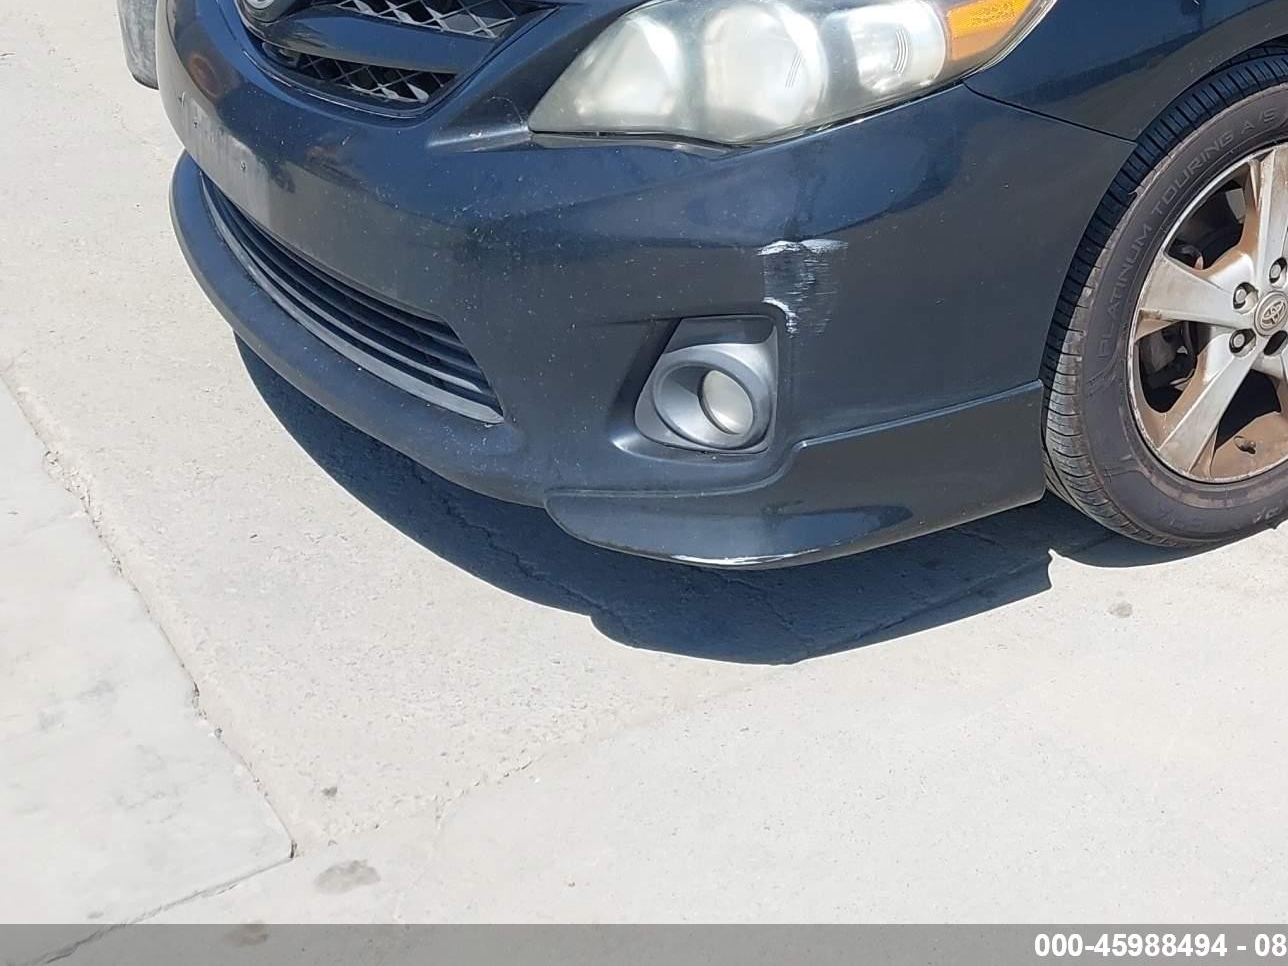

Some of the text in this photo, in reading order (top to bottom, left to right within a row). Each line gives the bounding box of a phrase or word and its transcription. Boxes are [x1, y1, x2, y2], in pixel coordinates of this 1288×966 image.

[1096, 108, 1277, 360] PLATINUM TOURING A/S
